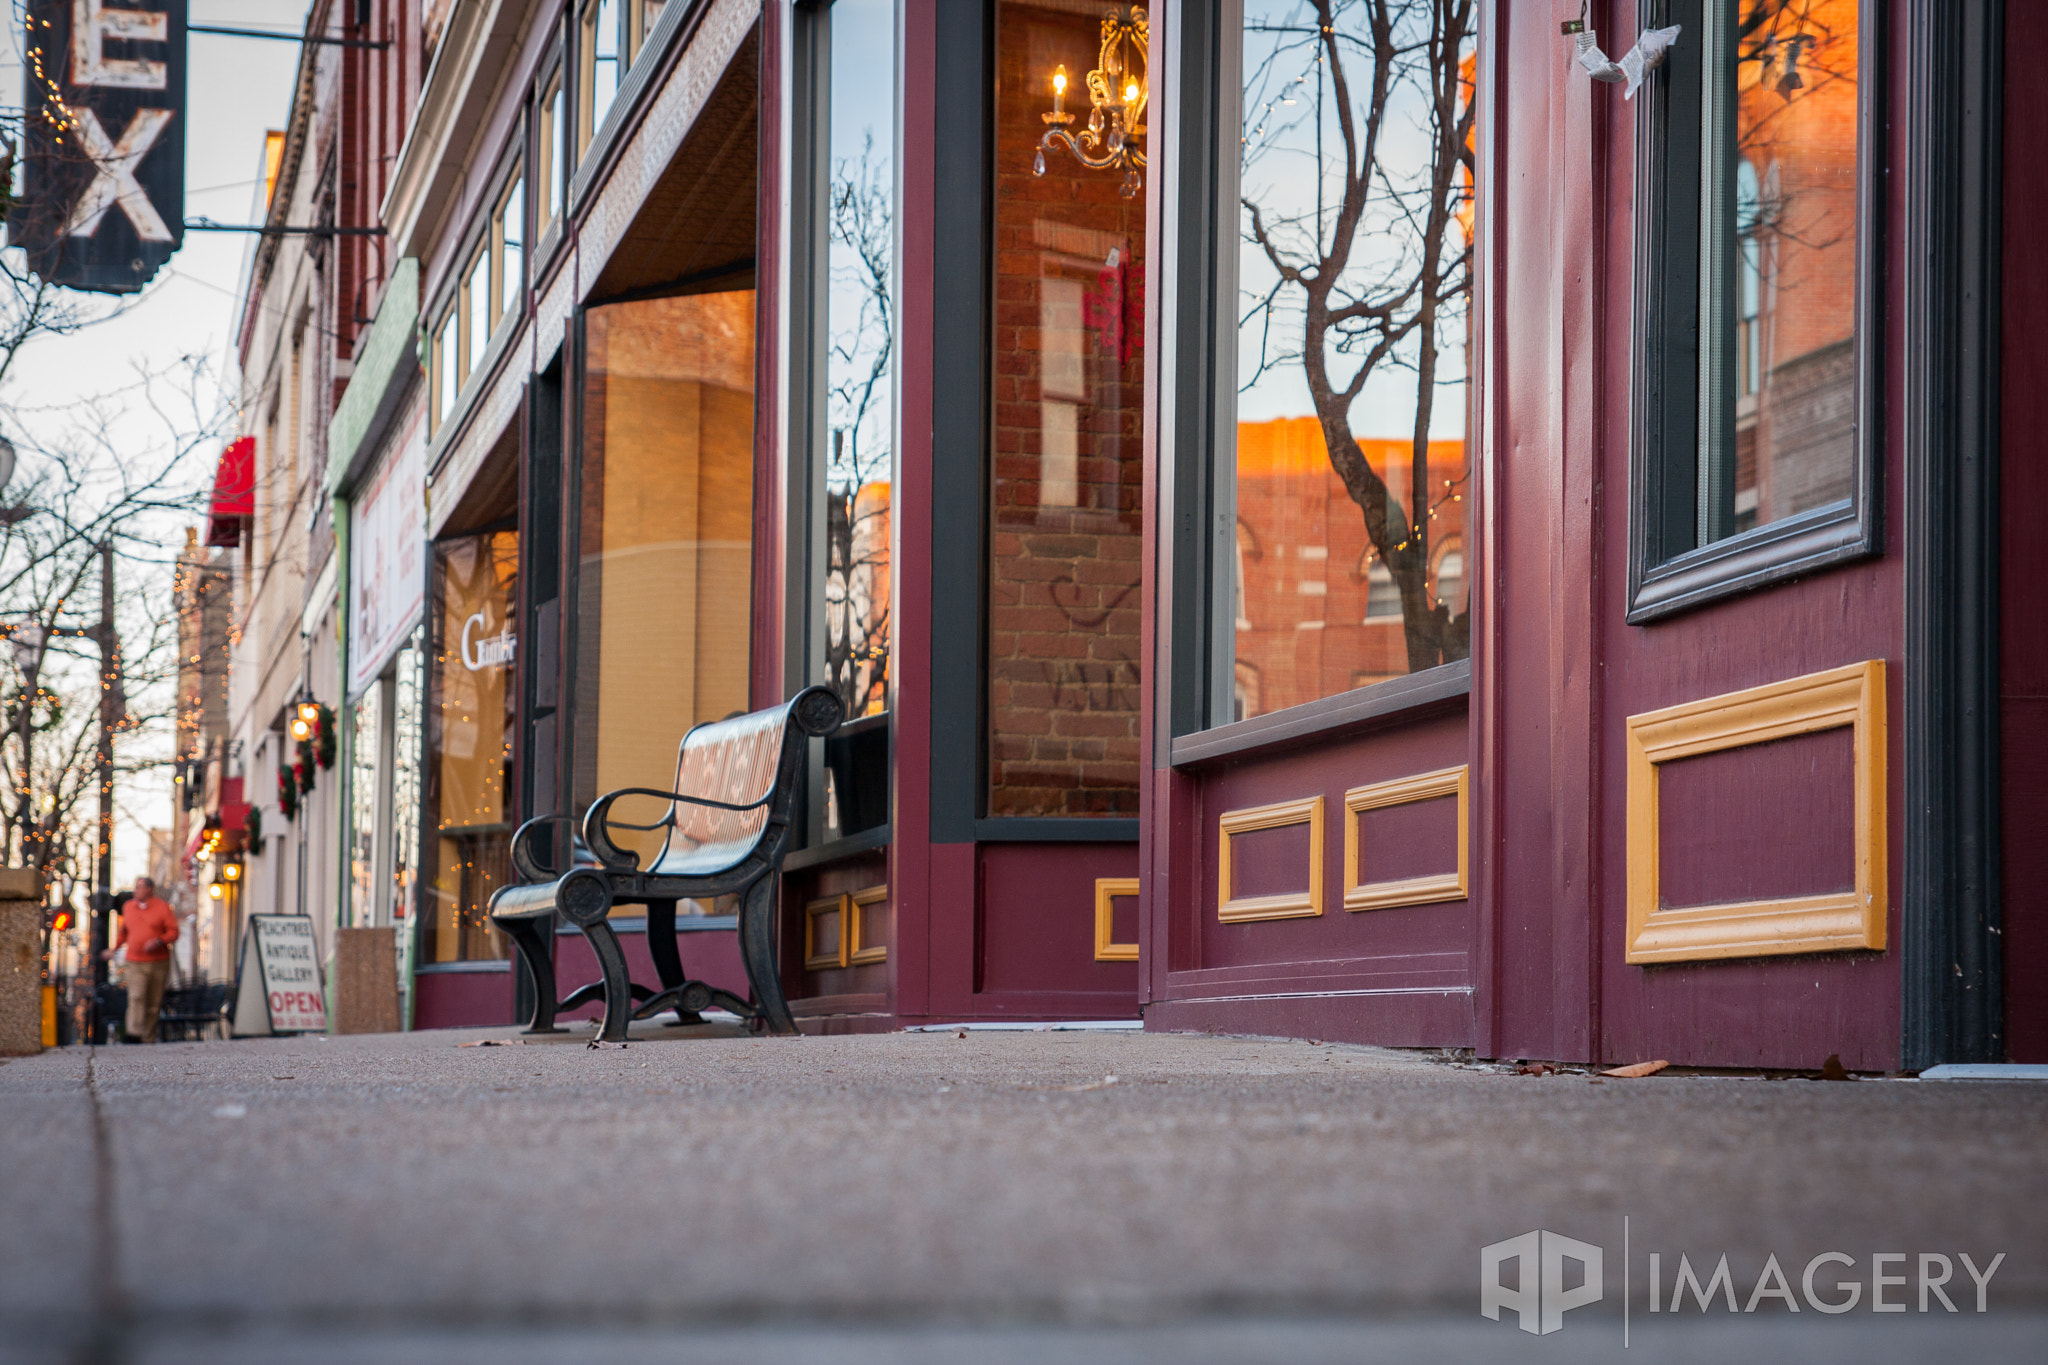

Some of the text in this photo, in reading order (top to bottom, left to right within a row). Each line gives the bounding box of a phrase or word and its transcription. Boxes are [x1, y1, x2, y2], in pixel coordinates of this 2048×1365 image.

[256, 919, 311, 937] PEACHTREE
[265, 942, 311, 960] ANTIQUE
[267, 964, 313, 982] GALLERY
[269, 991, 323, 1013] OPEN
